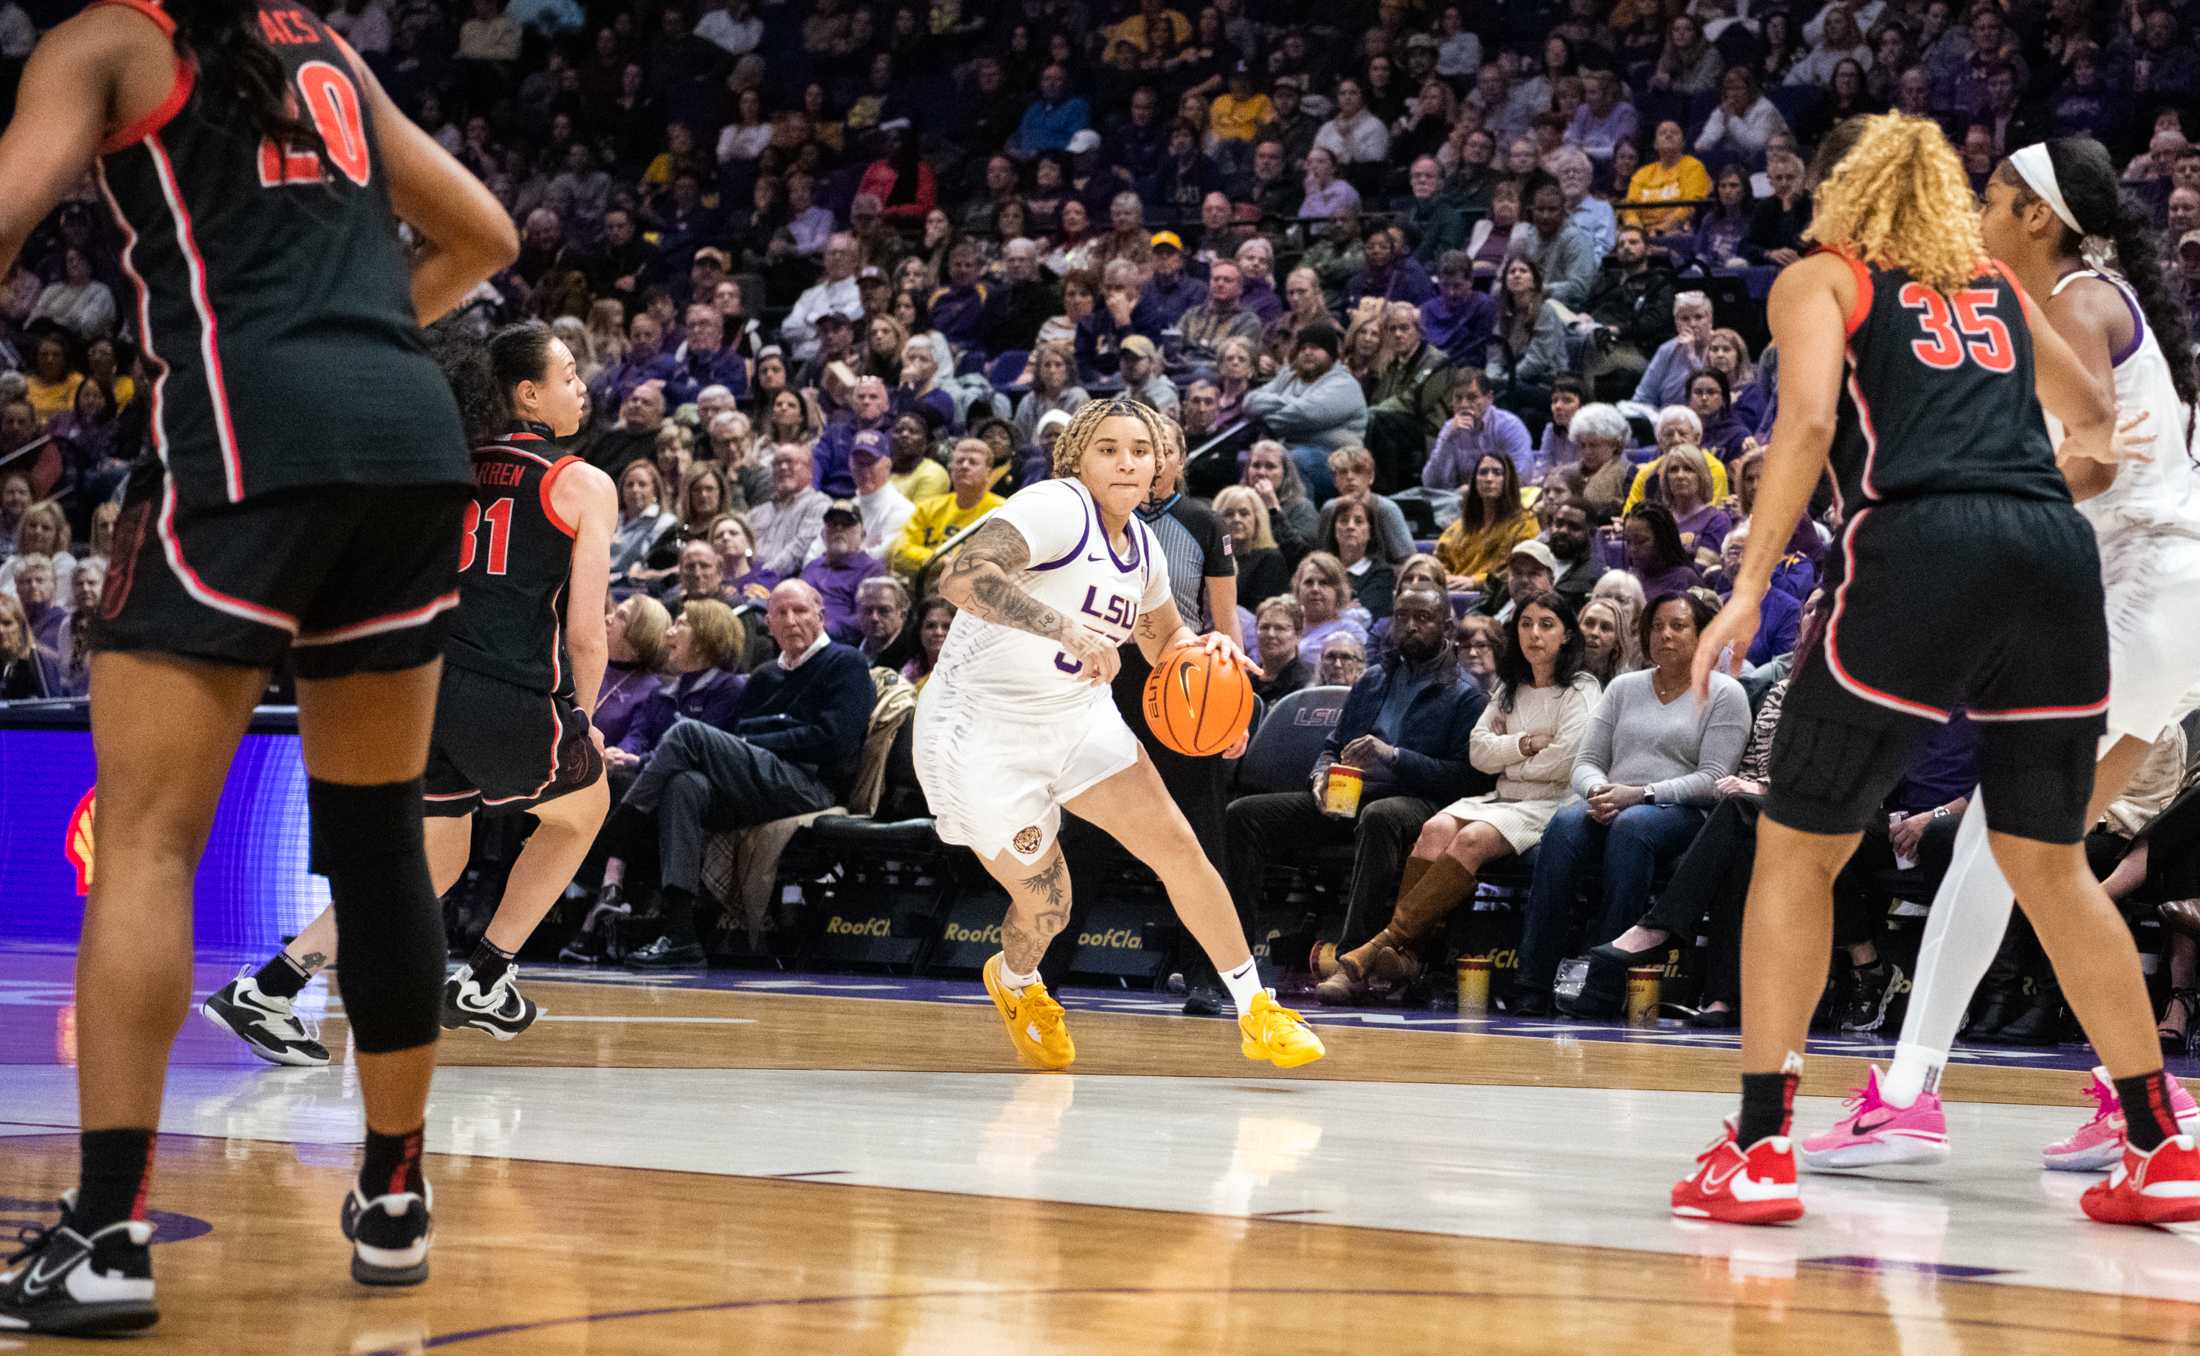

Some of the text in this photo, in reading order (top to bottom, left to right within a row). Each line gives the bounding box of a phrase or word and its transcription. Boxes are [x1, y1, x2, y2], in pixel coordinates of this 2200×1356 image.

[1898, 281, 2016, 373] 35
[1081, 585, 1138, 630] LSU
[1148, 660, 1169, 719] ELITE
